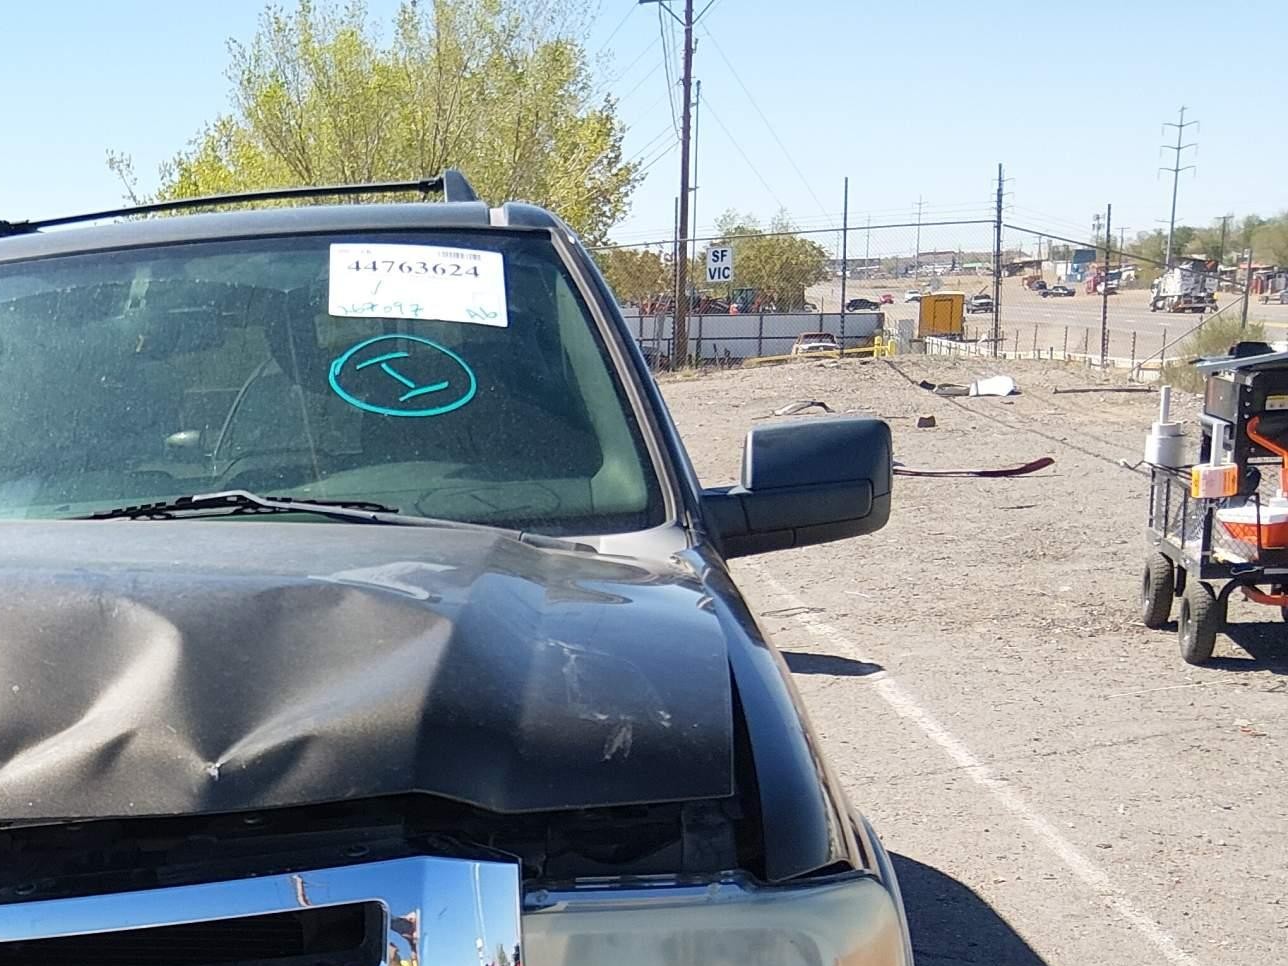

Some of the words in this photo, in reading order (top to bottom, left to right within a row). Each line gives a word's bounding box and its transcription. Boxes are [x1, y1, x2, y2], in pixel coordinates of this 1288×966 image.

[711, 250, 728, 262] SF
[347, 260, 480, 278] 44763624
[708, 266, 730, 280] VIC
